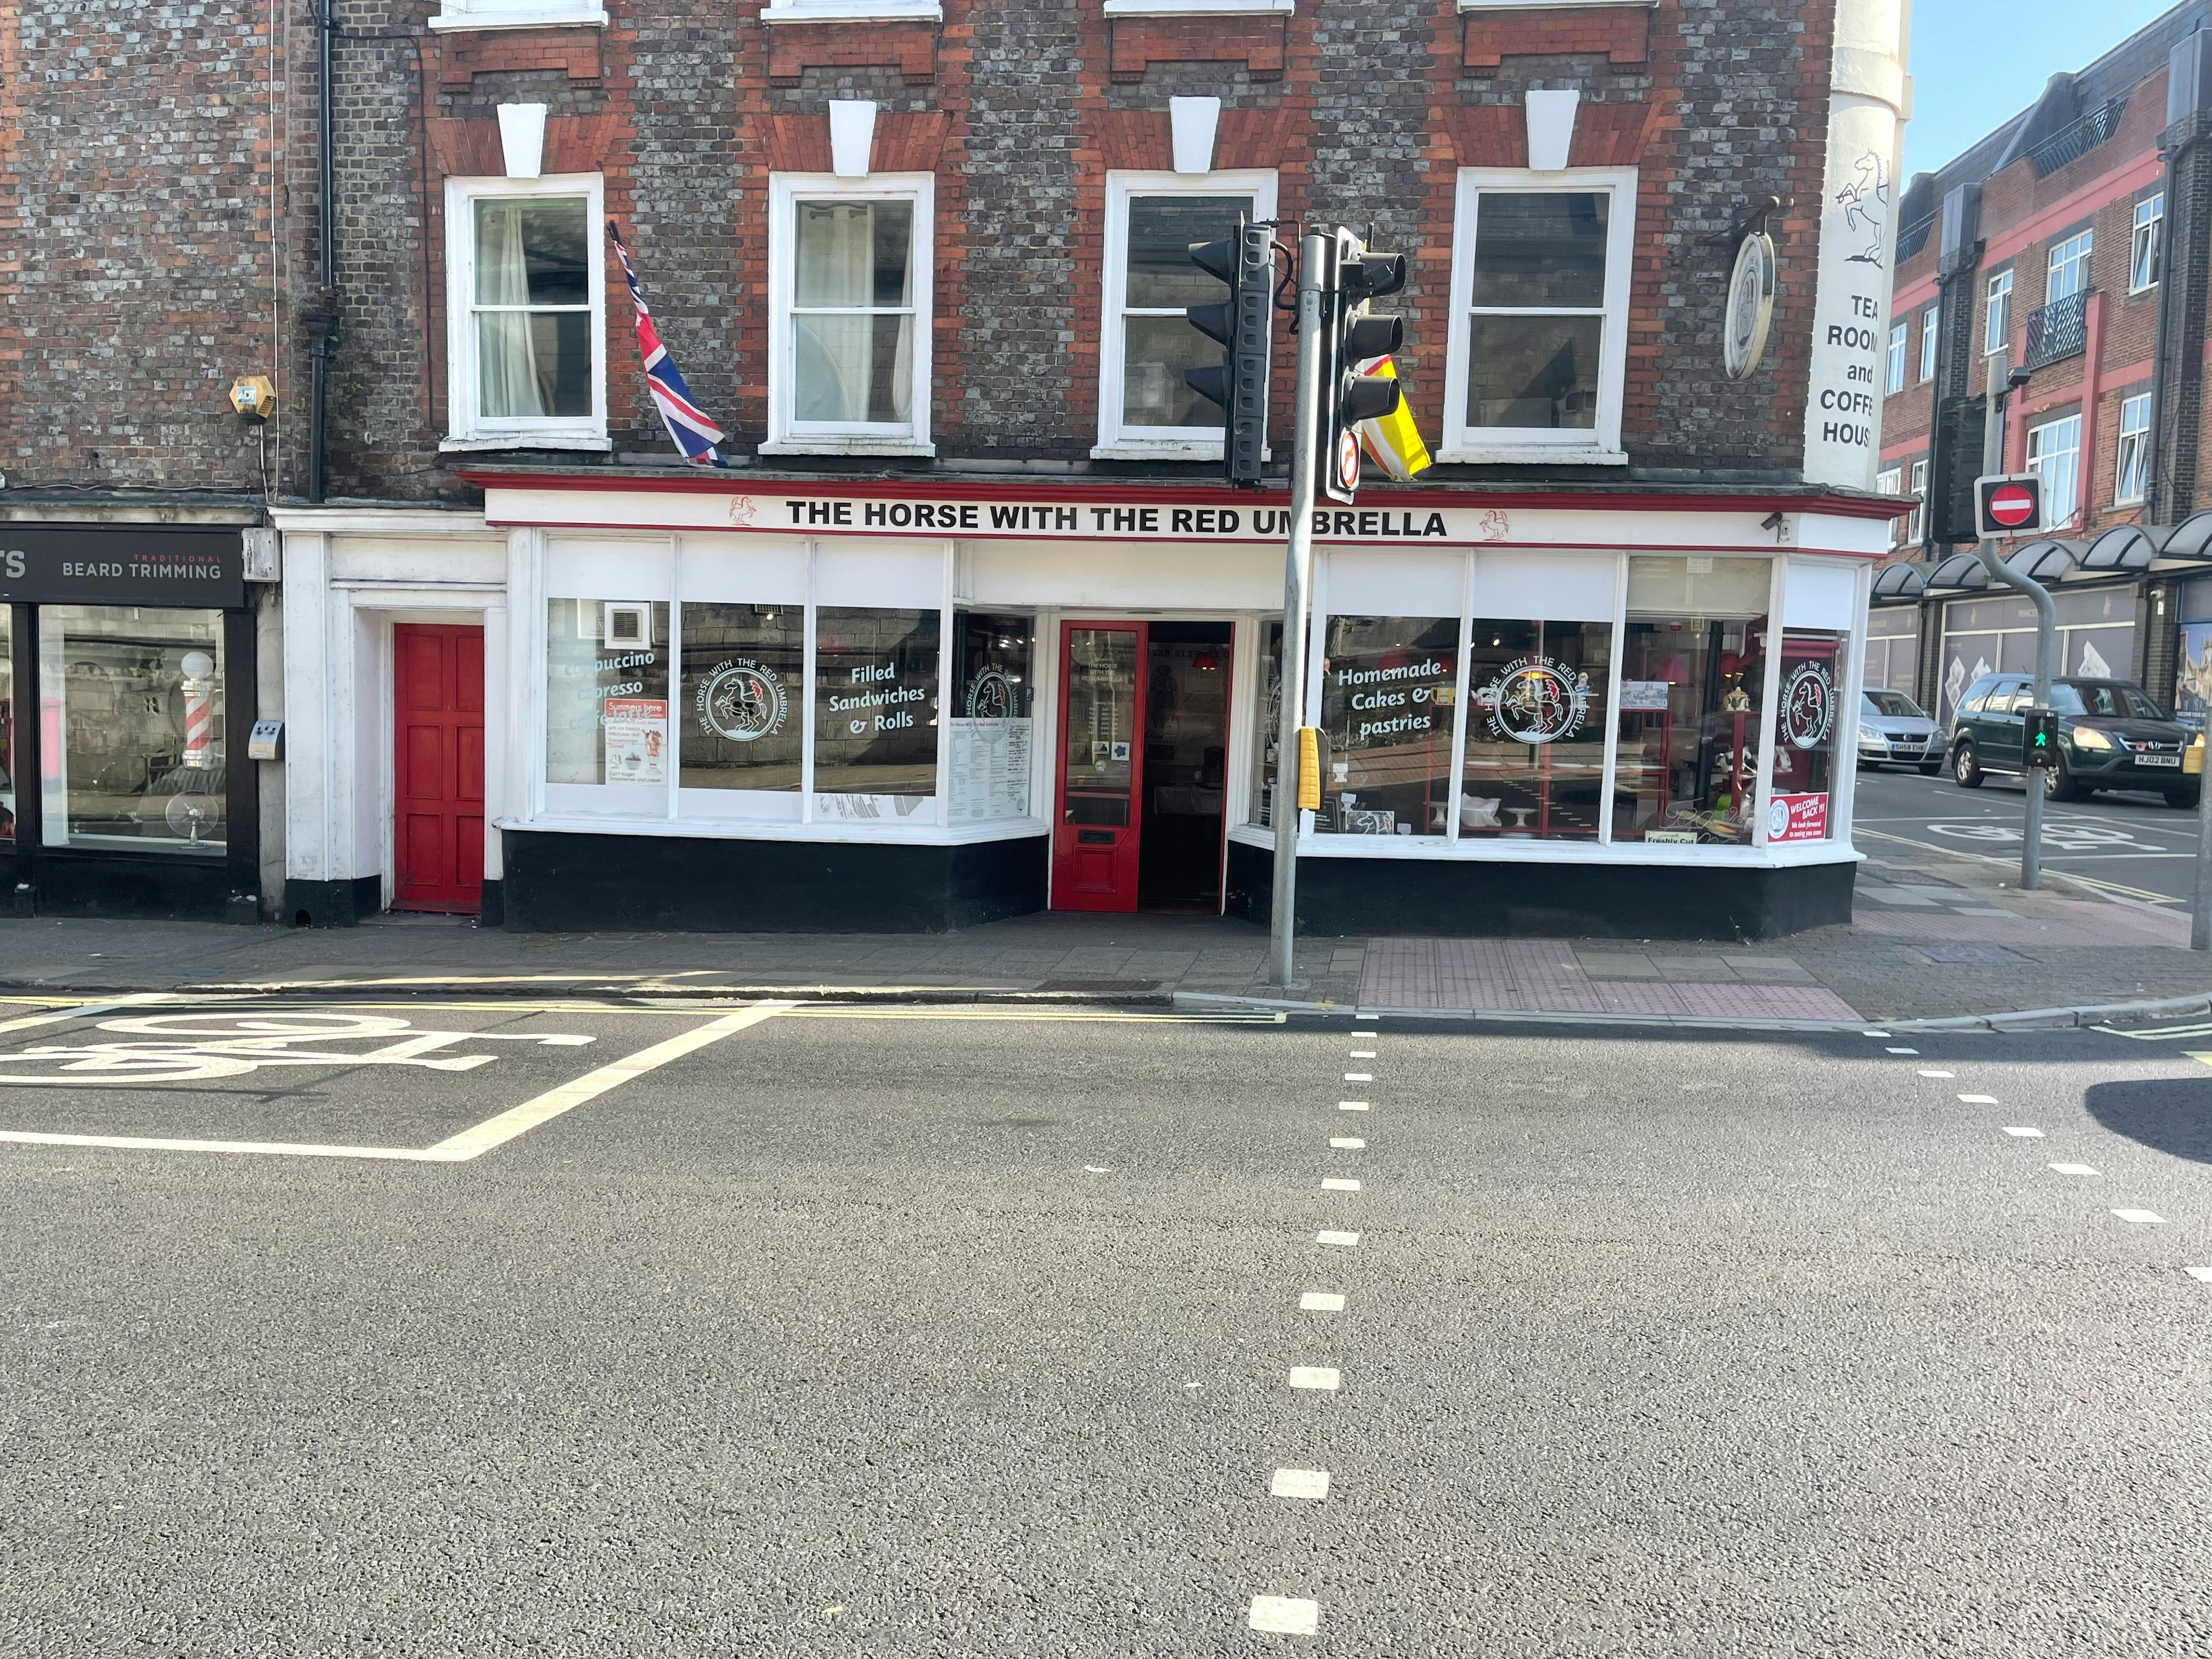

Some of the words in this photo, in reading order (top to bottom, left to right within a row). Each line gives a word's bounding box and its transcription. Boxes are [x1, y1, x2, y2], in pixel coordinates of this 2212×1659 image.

[1852, 295, 1877, 321] TEA
[1847, 364, 1873, 384] and
[239, 390, 255, 400] ADT
[1823, 421, 1870, 448] HOUS
[786, 501, 852, 525] THE
[865, 503, 979, 528] HORSE
[990, 505, 1077, 531] WITH
[1090, 507, 1159, 532] THE
[1171, 509, 1239, 533] RED
[134, 554, 222, 563] TRADITIONAL
[63, 562, 123, 577] BEARD
[129, 563, 221, 579] TRIMMING
[565, 651, 655, 676] puccino
[737, 658, 757, 669] THE
[1175, 649, 1220, 658] HISTY
[708, 659, 733, 677] WITH
[759, 664, 777, 681] RED
[851, 662, 895, 684] Filled
[974, 664, 990, 681] WITH
[991, 663, 1003, 673] THE
[1338, 658, 1441, 686] Homemade
[1791, 662, 1807, 681] WITH
[1809, 661, 1821, 671] THE
[1821, 667, 1831, 685] RED
[696, 678, 710, 711] HORSE
[829, 686, 926, 712] Sandwiches
[1351, 690, 1406, 710] Cakes
[1412, 687, 1431, 703] &
[1486, 715, 1502, 737] THE
[1500, 656, 1528, 675] WITH
[1533, 655, 1555, 667] THE
[1558, 662, 1577, 684] RED
[1780, 681, 1792, 718] HORSE
[770, 684, 788, 735] UMBRELLA
[1821, 687, 1835, 741] UMBRELLA
[699, 715, 713, 735] THE
[850, 720, 867, 734] &
[874, 711, 914, 731] Rolls
[1359, 713, 1431, 741] pastries
[1781, 721, 1789, 743] THE
[1790, 795, 1819, 815] WELCOME
[1802, 805, 1818, 820] BACK
